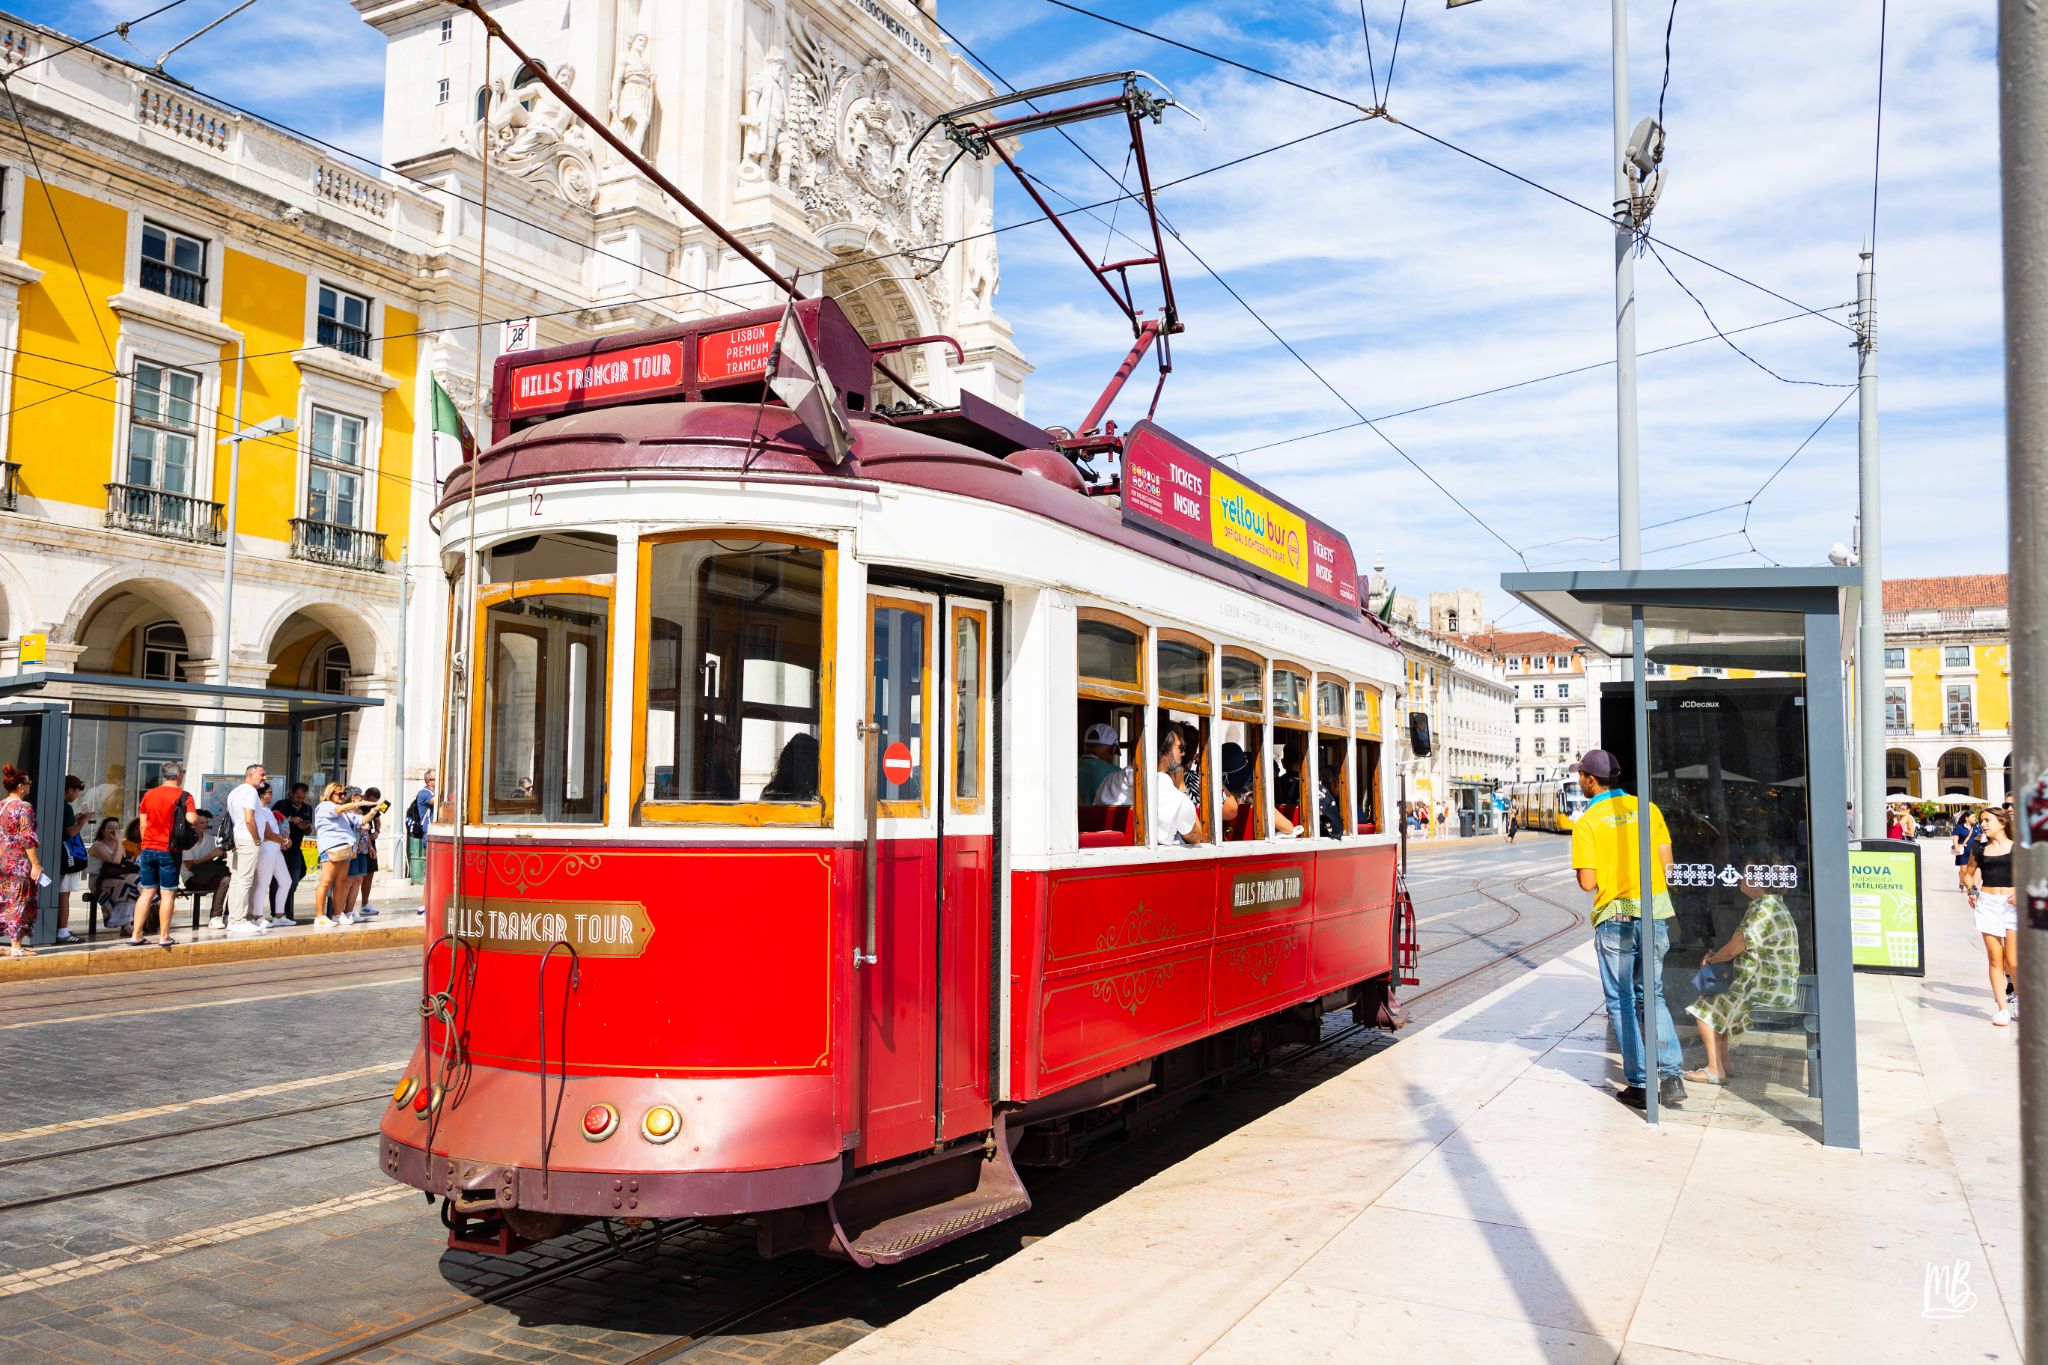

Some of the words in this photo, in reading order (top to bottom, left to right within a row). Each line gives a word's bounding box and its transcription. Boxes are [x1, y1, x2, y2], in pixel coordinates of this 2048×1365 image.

[512, 327, 523, 341] 28
[731, 328, 765, 344] LISBON
[727, 342, 769, 359] PREMIUM
[521, 371, 562, 398] HILLS
[566, 360, 629, 390] TRAMCAR
[633, 354, 671, 380] TOUR
[726, 357, 768, 375] TRAMCAR
[1169, 463, 1203, 496] TICKETS
[528, 493, 543, 517] 12
[1173, 492, 1200, 521] INSIDE
[1266, 511, 1286, 547] bus
[1312, 540, 1334, 563] TICKETS
[1315, 562, 1333, 584] INSIDE
[1680, 701, 1720, 709] JCDecaux
[1852, 865, 1891, 875] NOVA
[1852, 875, 1892, 884] Papeleira
[1234, 882, 1256, 906] HILLS
[1257, 879, 1284, 903] TRAMCAR
[1285, 877, 1300, 899] TOUR
[1852, 882, 1904, 890] INTELIGENTE
[488, 910, 568, 942] TRAMCAR
[574, 914, 633, 944] TOUR
